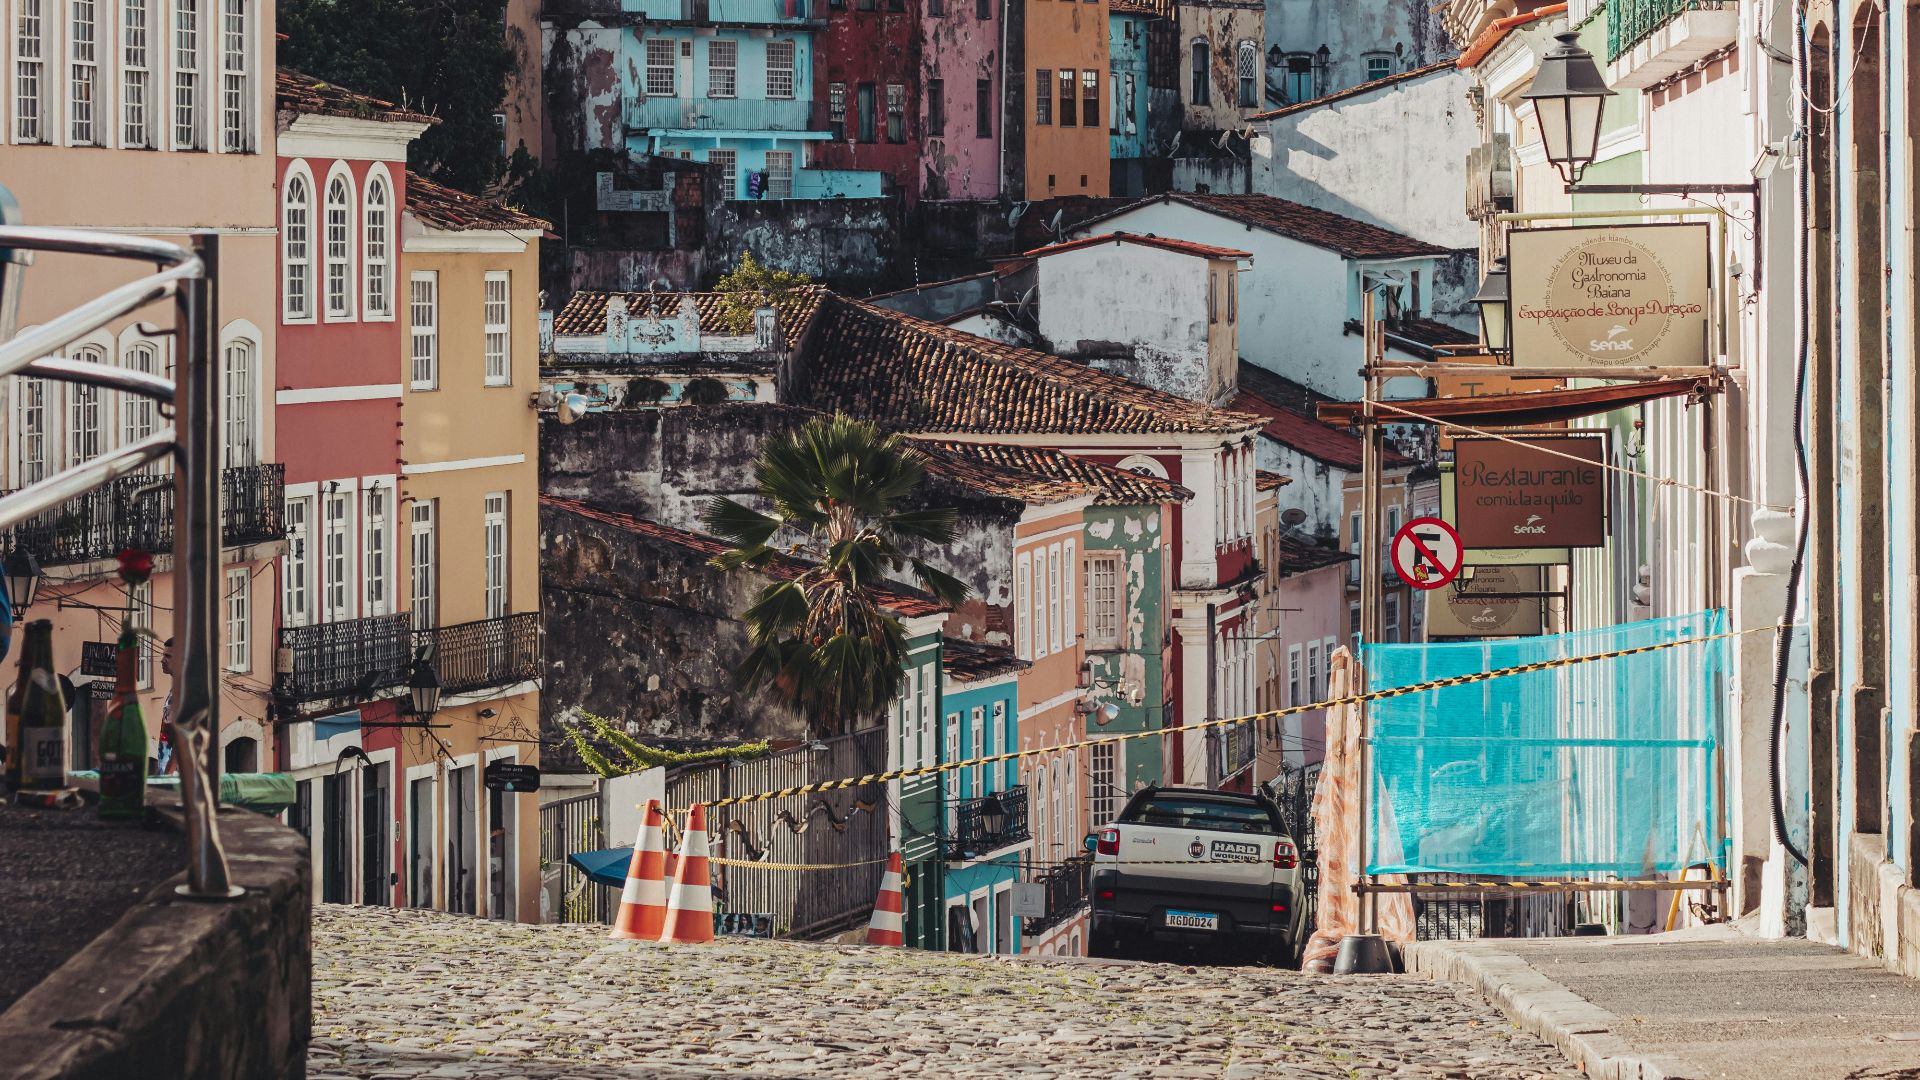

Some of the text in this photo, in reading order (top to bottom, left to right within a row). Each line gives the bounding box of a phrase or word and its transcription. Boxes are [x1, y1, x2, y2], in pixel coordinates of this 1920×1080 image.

[1557, 245, 1580, 264] kiambo
[1581, 234, 1606, 248] ndende
[1608, 233, 1633, 246] kiambo
[1578, 249, 1637, 267] Museu da
[1571, 266, 1646, 290] Gastronomia
[1587, 284, 1631, 299] Baiana
[1518, 299, 1702, 326] Exposição de Longa Duração
[1461, 460, 1596, 487] Restaurante
[1476, 489, 1583, 514] comida a quilo
[1214, 842, 1257, 854] HARD
[1214, 852, 1257, 861] WORKING
